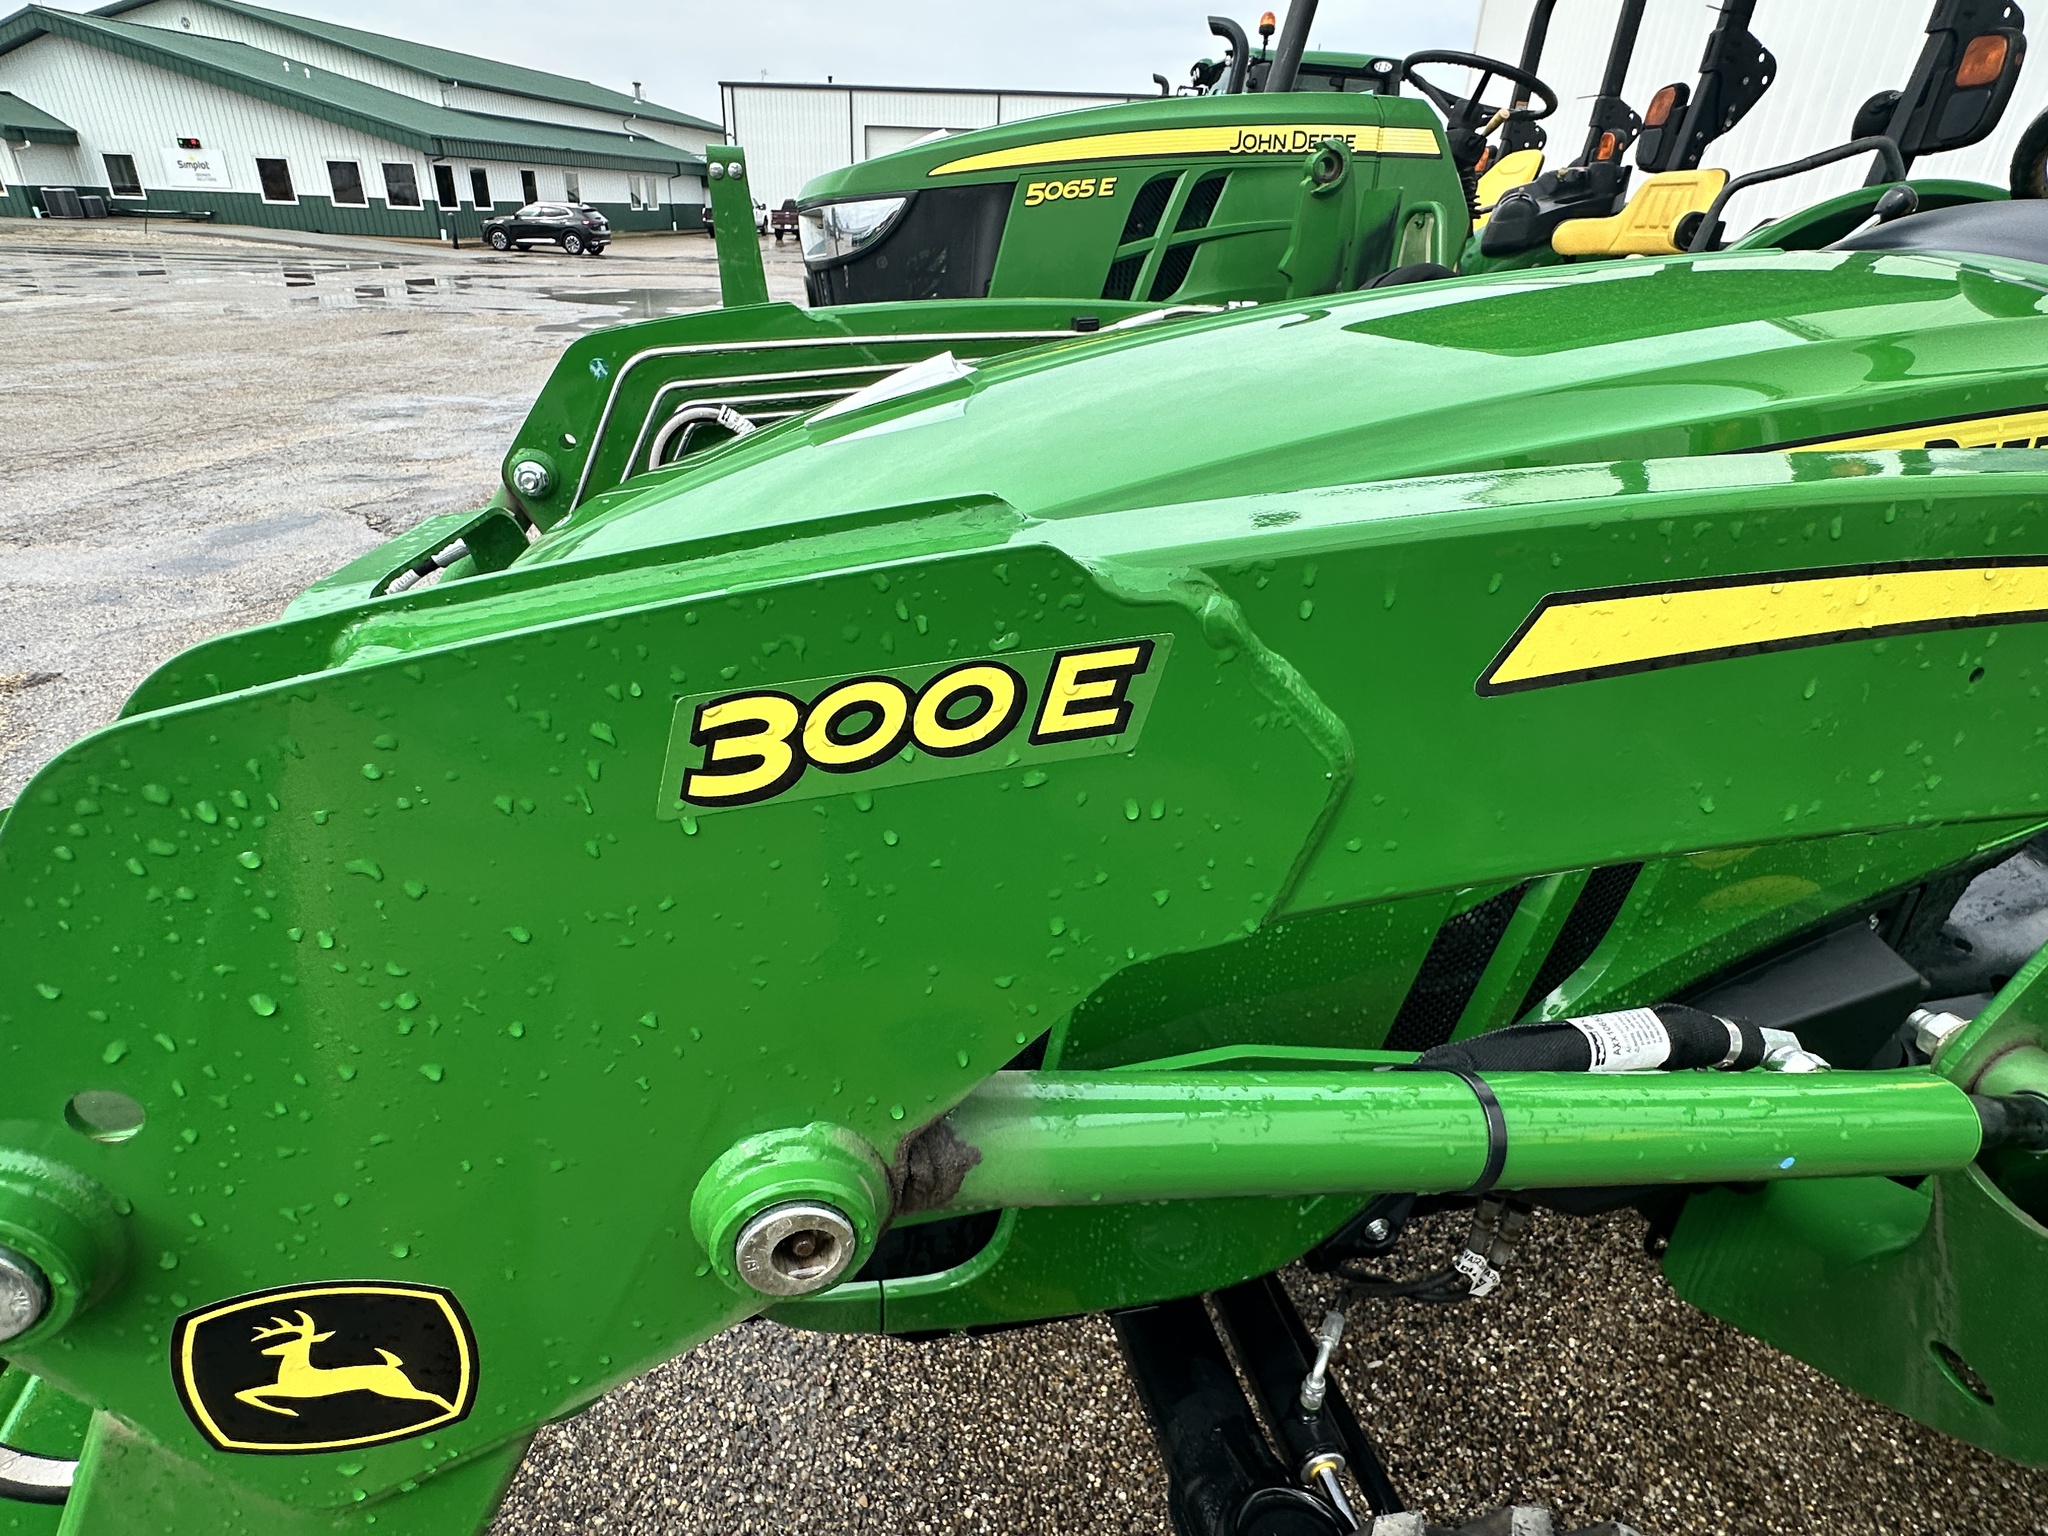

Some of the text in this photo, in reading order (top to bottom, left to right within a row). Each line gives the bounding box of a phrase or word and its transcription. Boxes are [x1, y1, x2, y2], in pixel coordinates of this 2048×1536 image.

[1229, 130, 1287, 150] JOHN
[177, 160, 210, 171] Simplot
[1024, 176, 1118, 207] 5065 E
[680, 639, 1155, 807] 300 E
